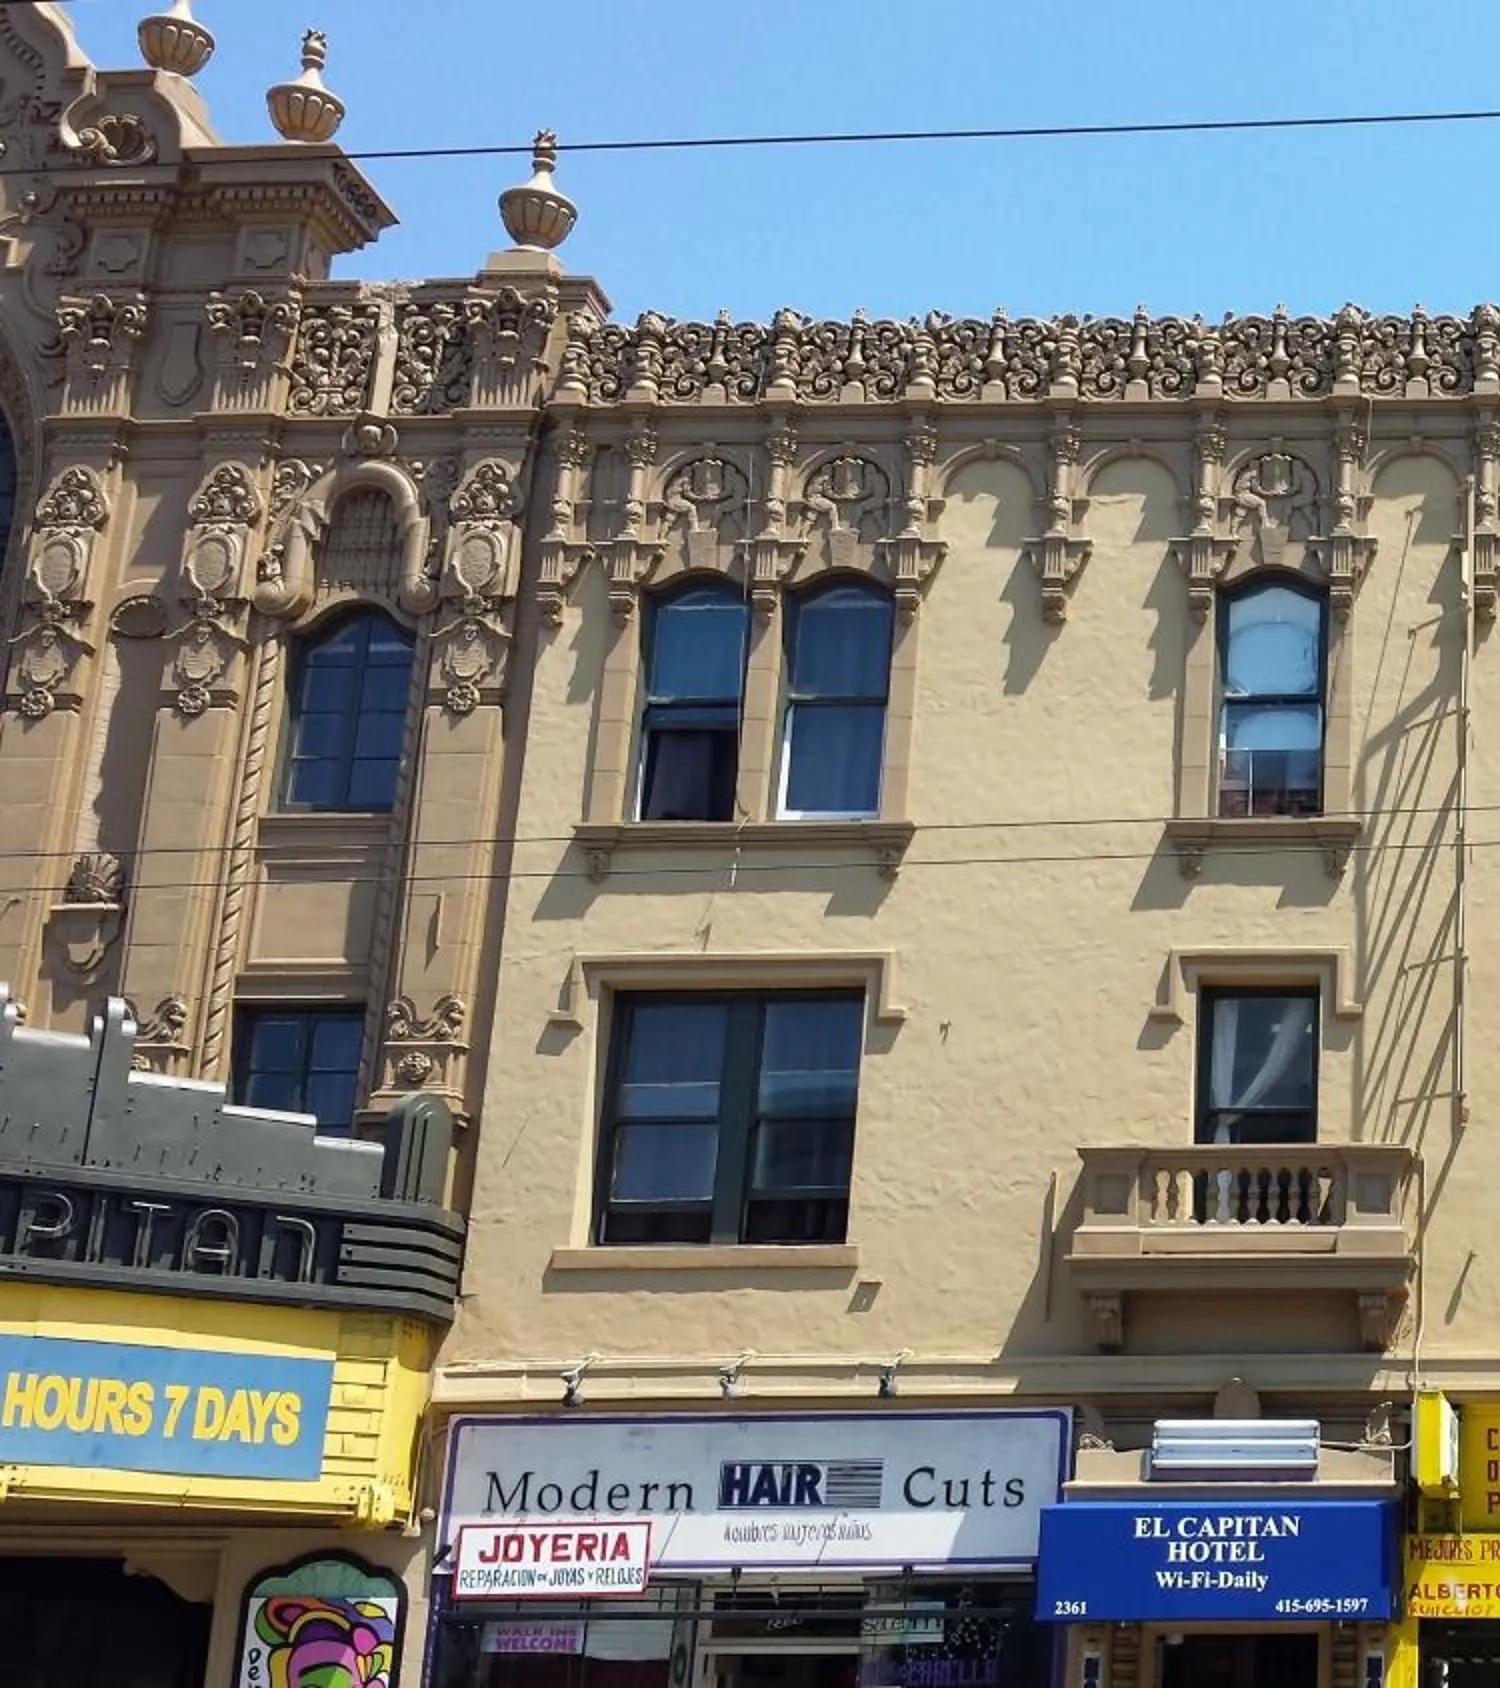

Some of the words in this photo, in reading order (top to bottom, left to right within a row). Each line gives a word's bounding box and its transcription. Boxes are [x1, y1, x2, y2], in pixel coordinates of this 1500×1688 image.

[2, 1374, 153, 1436] HOURS
[163, 1386, 190, 1437] 7
[192, 1388, 302, 1447] DAYS
[481, 1469, 693, 1516] Modern
[721, 1462, 824, 1506] HAIR
[904, 1467, 1025, 1507] Cuts
[1135, 1517, 1170, 1537] EL
[1178, 1516, 1300, 1537] CAPITAN
[479, 1533, 631, 1563] JOYERIA
[1167, 1541, 1265, 1562] HOTEL
[460, 1568, 536, 1588] REPARACION
[550, 1568, 584, 1586] JOYAS
[596, 1567, 643, 1585] RELOJES
[1156, 1571, 1268, 1592] Wi-Fi-Daily
[1055, 1601, 1087, 1615] 2361
[1275, 1598, 1368, 1613] 415-695-1597
[496, 1637, 577, 1650] WELCOME
